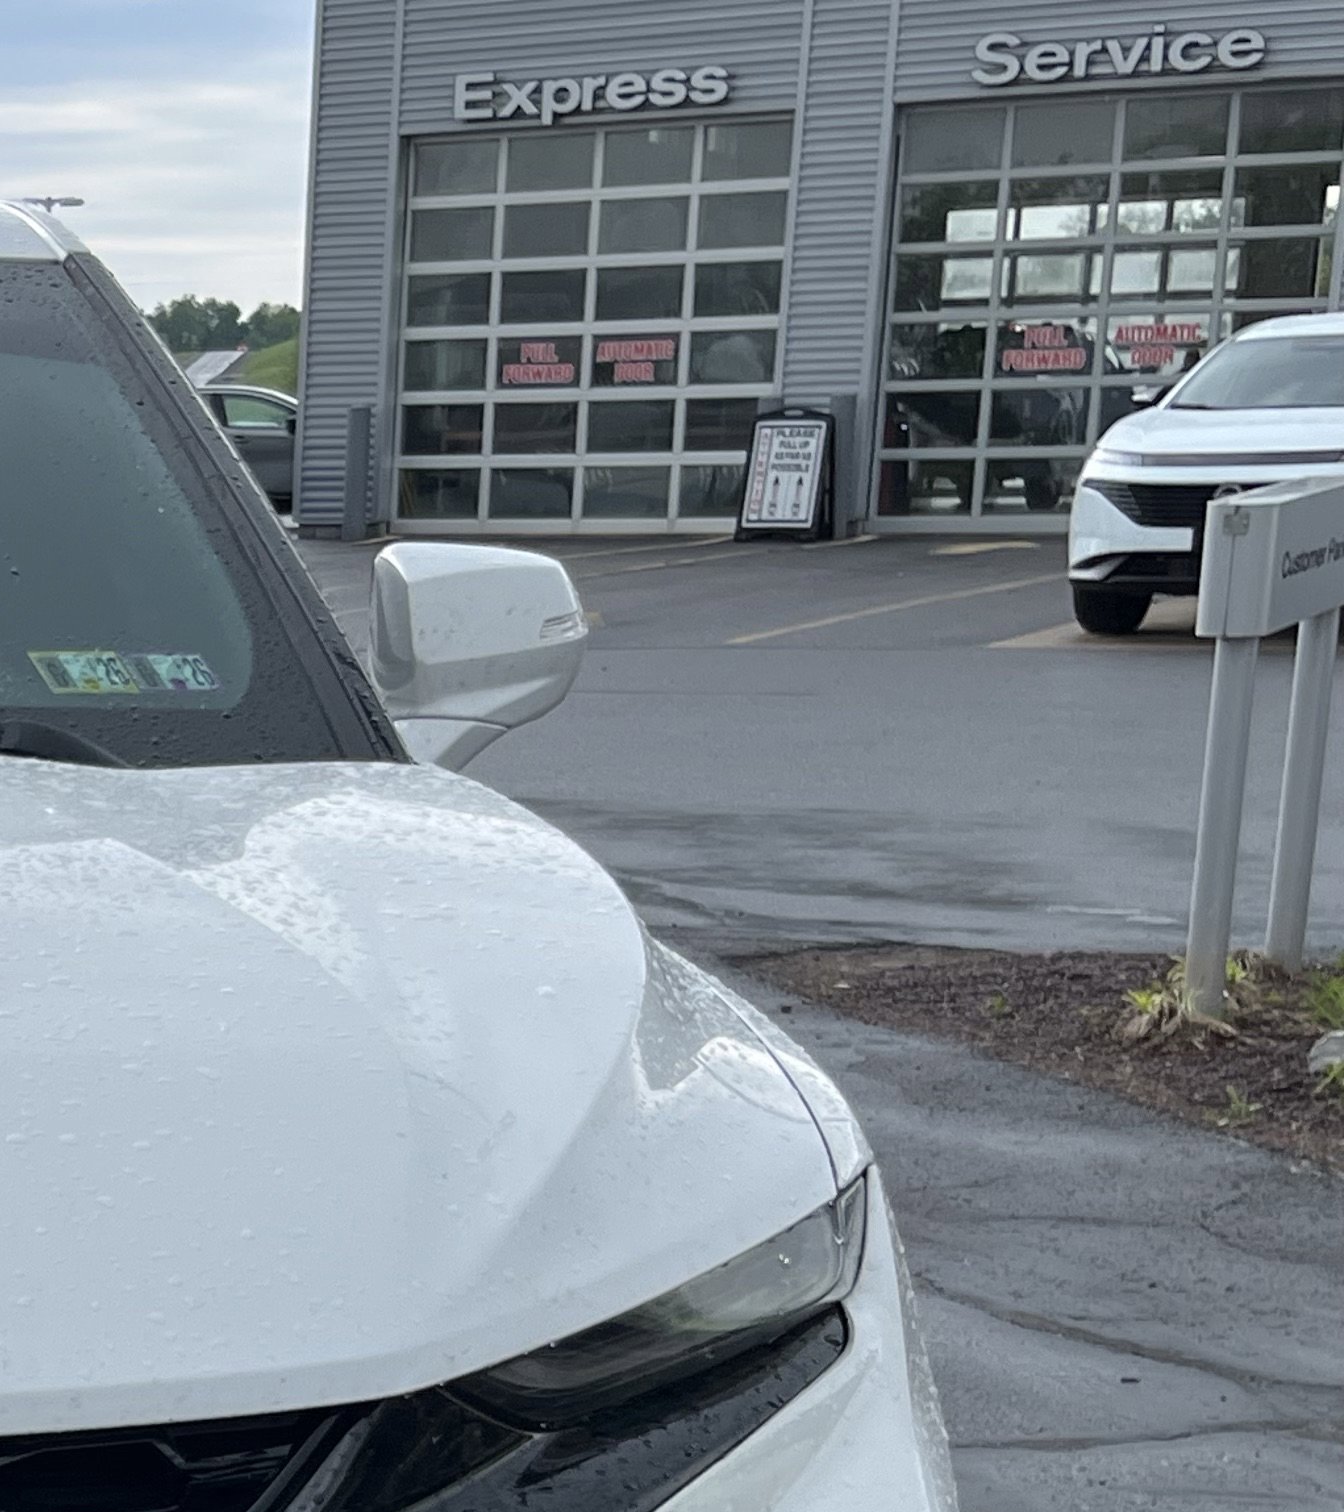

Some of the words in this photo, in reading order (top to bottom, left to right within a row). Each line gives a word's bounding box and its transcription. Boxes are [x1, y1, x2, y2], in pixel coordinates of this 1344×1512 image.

[971, 24, 1265, 86] Service
[454, 66, 729, 125] Express
[1023, 326, 1068, 348] PULL
[1115, 323, 1202, 343] AUTOMATIC
[521, 343, 559, 363] PULL
[596, 340, 675, 362] AUTOMATIC
[1003, 347, 1086, 371] FORWARD
[1130, 346, 1175, 367] DOOR
[502, 363, 575, 384] FORWARD
[614, 362, 654, 382] DOOR
[1282, 546, 1327, 579] Customer
